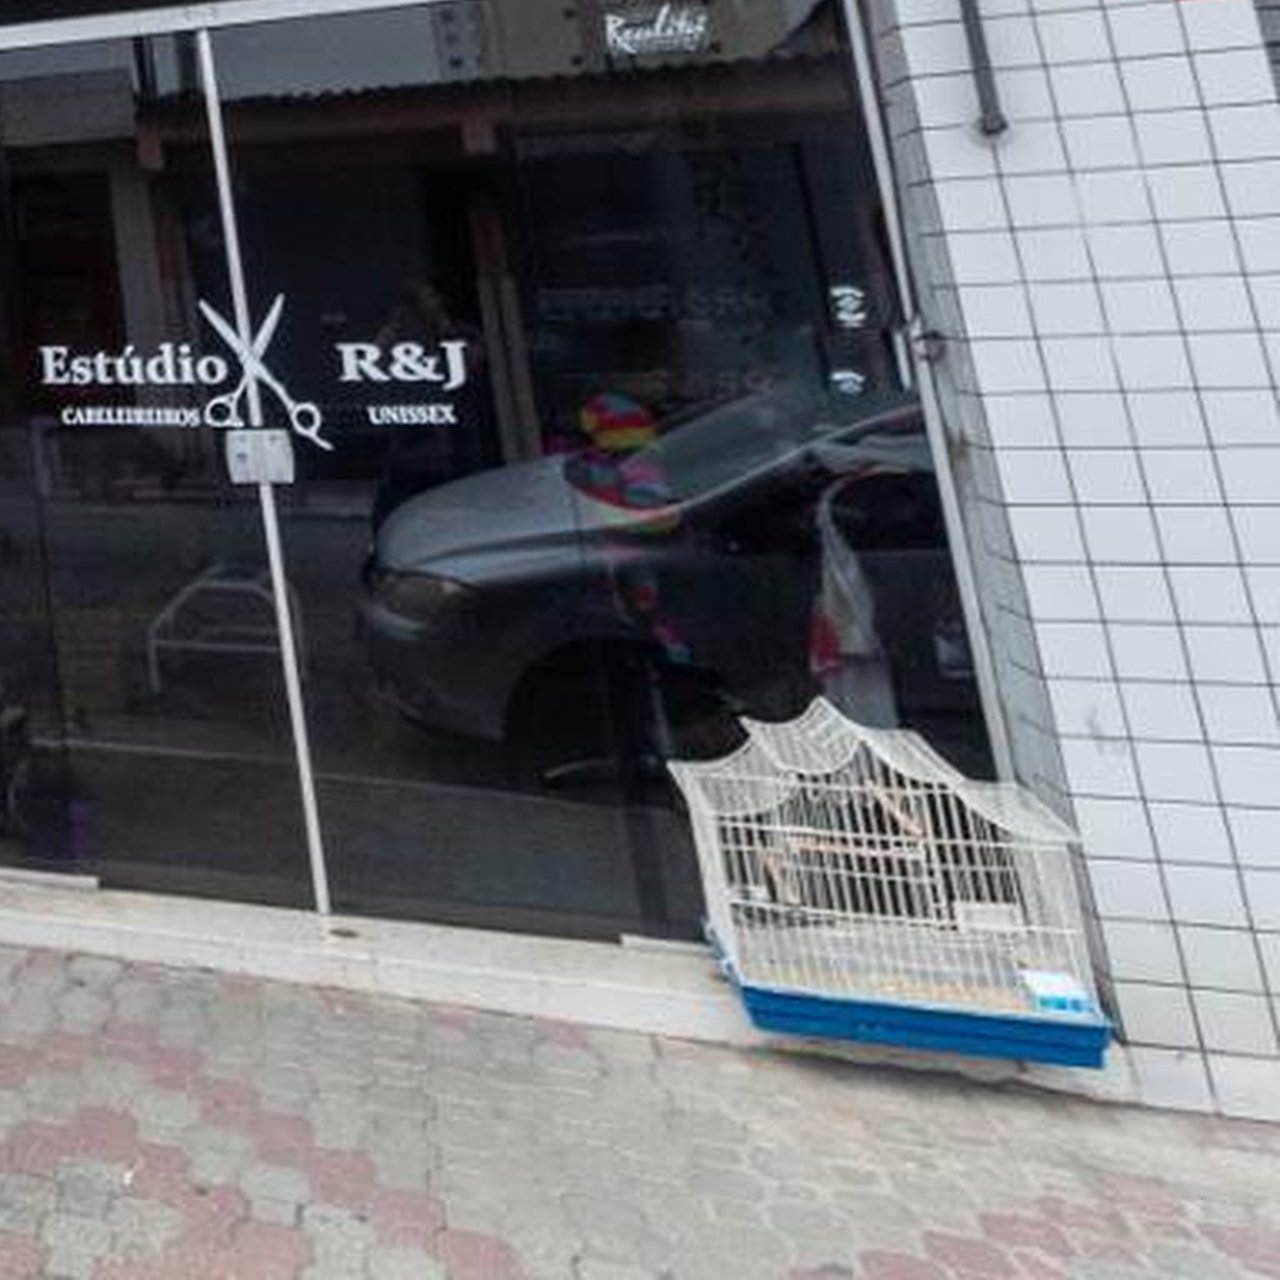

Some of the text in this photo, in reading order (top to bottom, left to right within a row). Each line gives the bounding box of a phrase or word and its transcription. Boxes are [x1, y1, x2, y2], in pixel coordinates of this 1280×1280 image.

[39, 338, 468, 391] Estúdio R&J
[366, 403, 458, 426] UNISSEX
